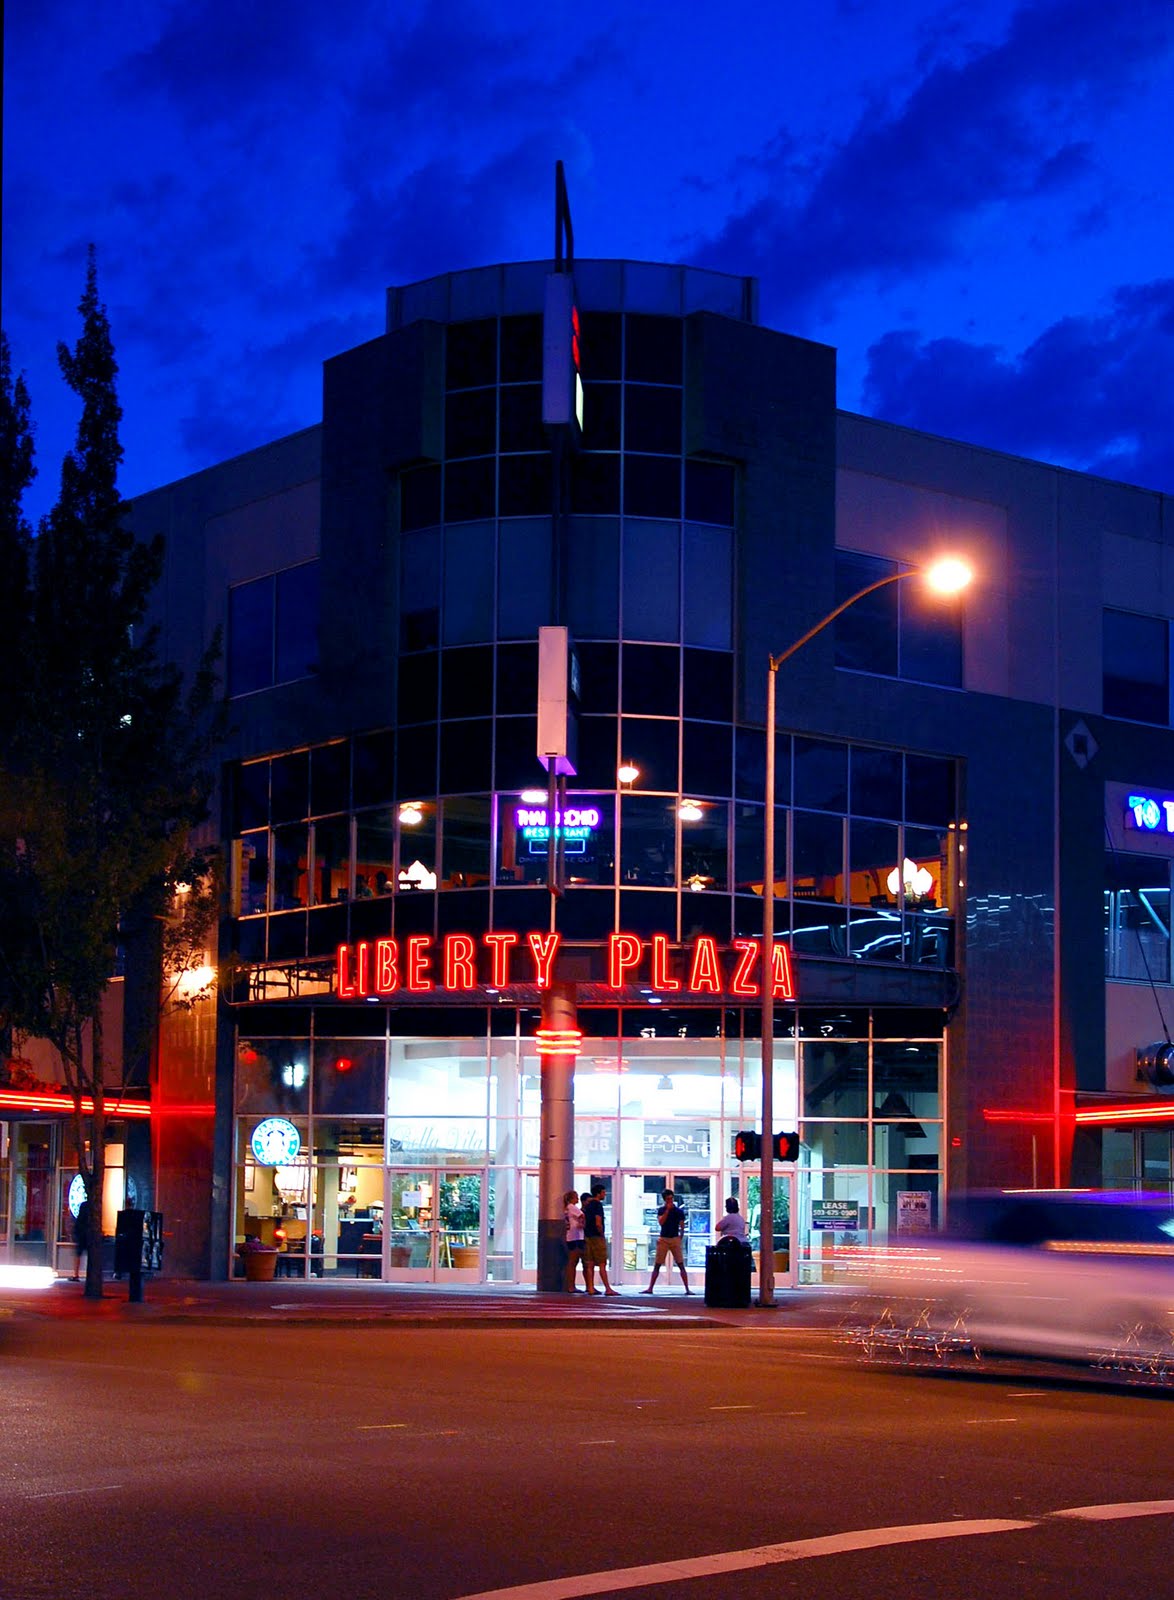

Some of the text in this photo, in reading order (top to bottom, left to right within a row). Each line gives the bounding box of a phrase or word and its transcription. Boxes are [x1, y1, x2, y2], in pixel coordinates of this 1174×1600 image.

[339, 934, 792, 998] LIBERTY PLAZA
[644, 1135, 694, 1144] TAN
